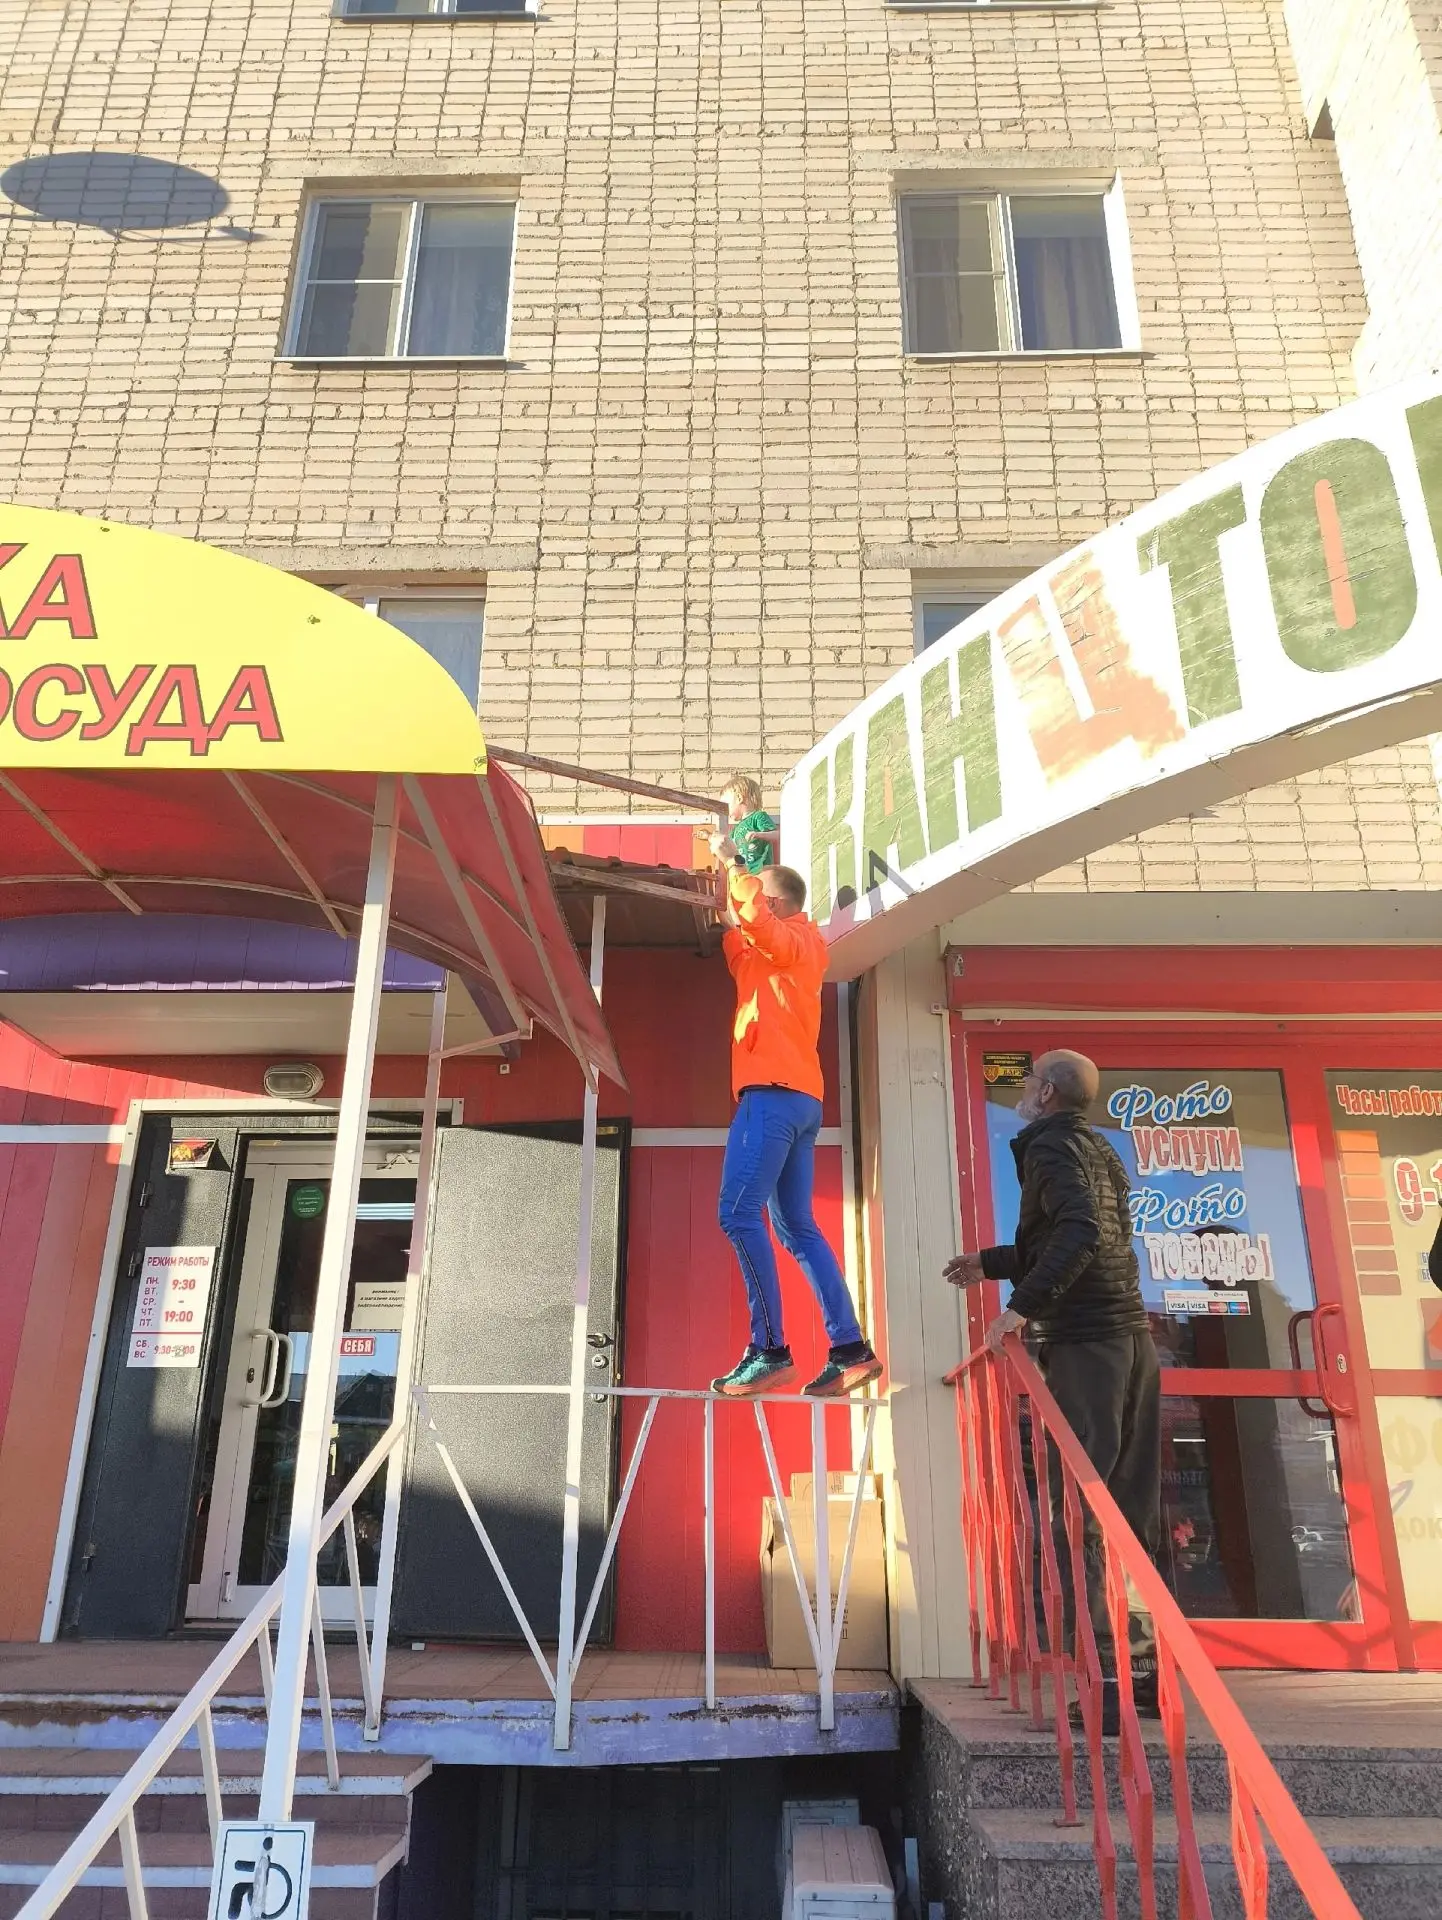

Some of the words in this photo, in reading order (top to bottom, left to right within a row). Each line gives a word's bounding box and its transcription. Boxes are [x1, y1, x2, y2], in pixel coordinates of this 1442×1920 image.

[0, 543, 98, 640] А
[0, 663, 284, 757] СУДА
[1108, 1081, 1232, 1130] Фото
[1336, 1085, 1390, 1115] Часы
[1128, 1183, 1246, 1236] Фото
[147, 1256, 177, 1267] РЕЖИМ
[178, 1256, 210, 1267] РАБОТЫ
[171, 1278, 196, 1290] 9:30
[163, 1310, 194, 1322] 19:00
[343, 1339, 373, 1353] СЕБЯ
[1382, 1415, 1442, 1474] Ф
